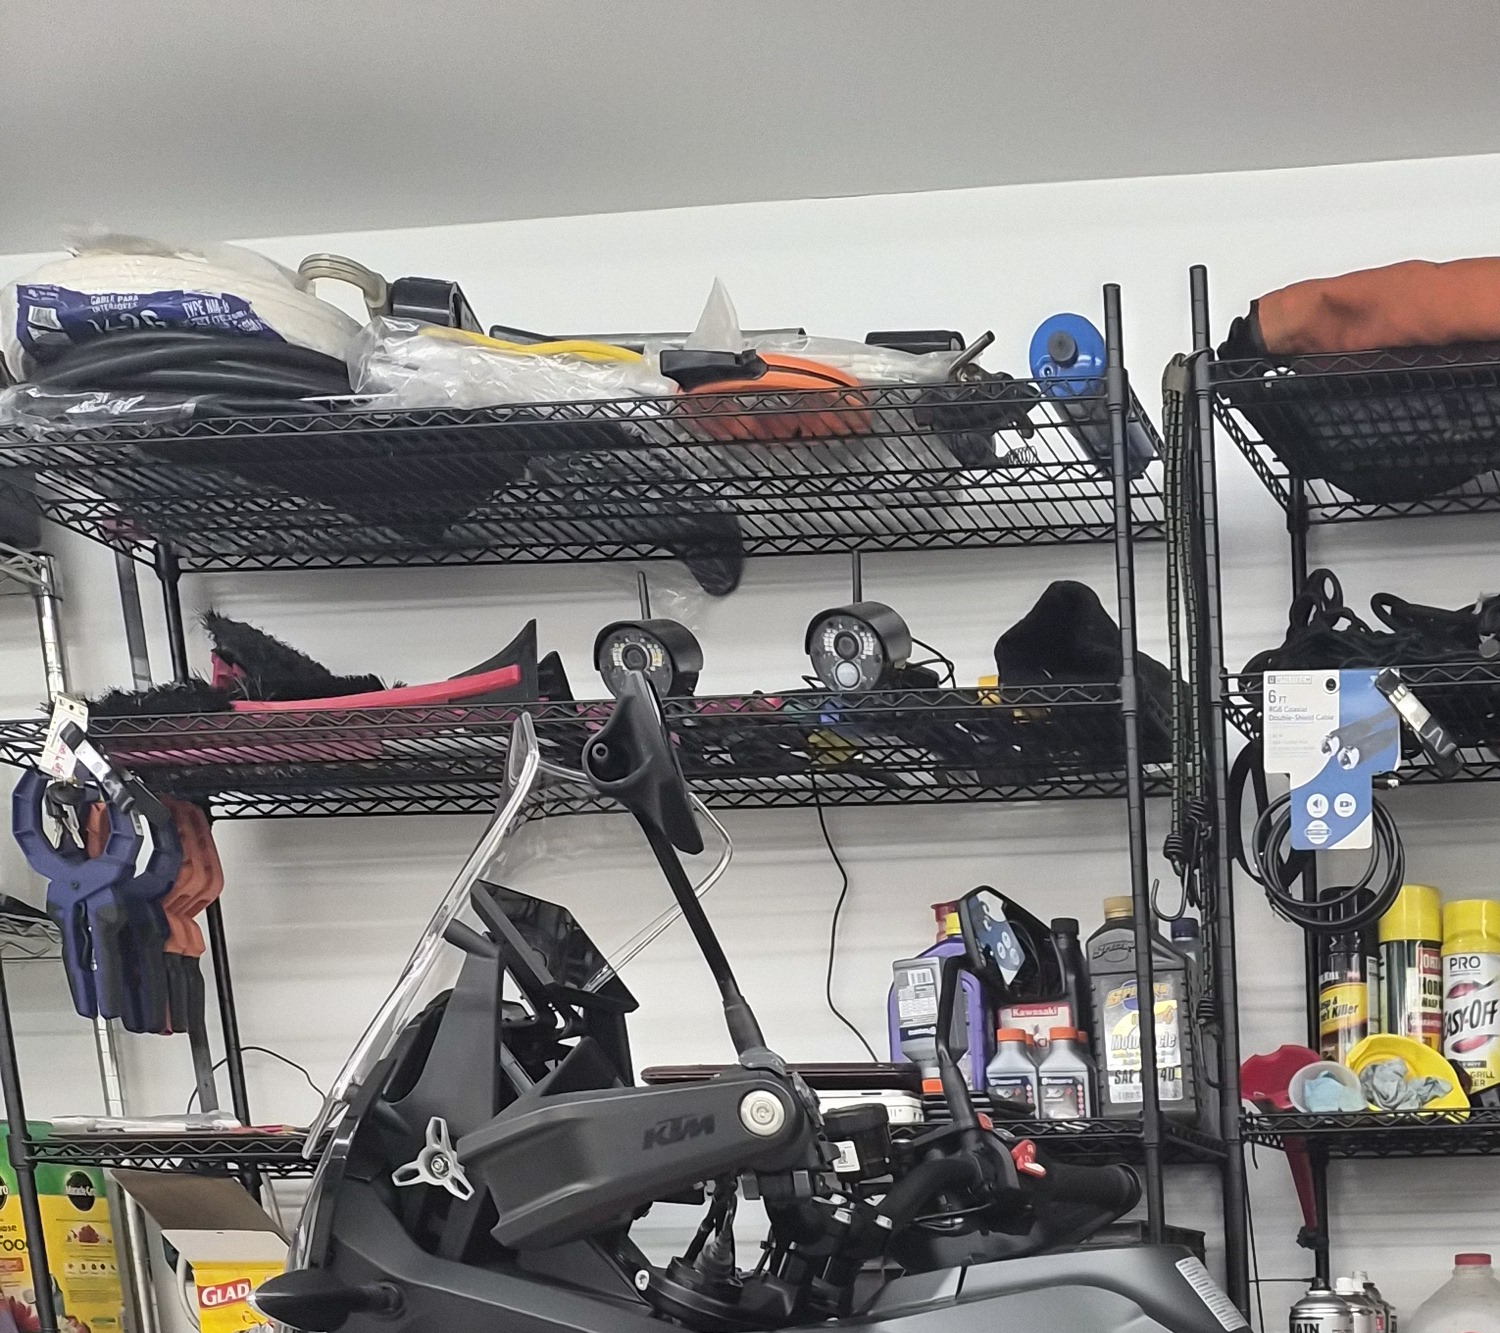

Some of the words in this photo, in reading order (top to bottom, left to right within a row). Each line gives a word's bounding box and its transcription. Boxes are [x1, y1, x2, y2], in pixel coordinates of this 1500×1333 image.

[1268, 690, 1276, 703] 6
[1449, 955, 1481, 970] PRO
[1012, 1007, 1058, 1016] Kawasaki
[643, 1113, 715, 1149] KTM
[201, 1281, 250, 1306] GLAD
